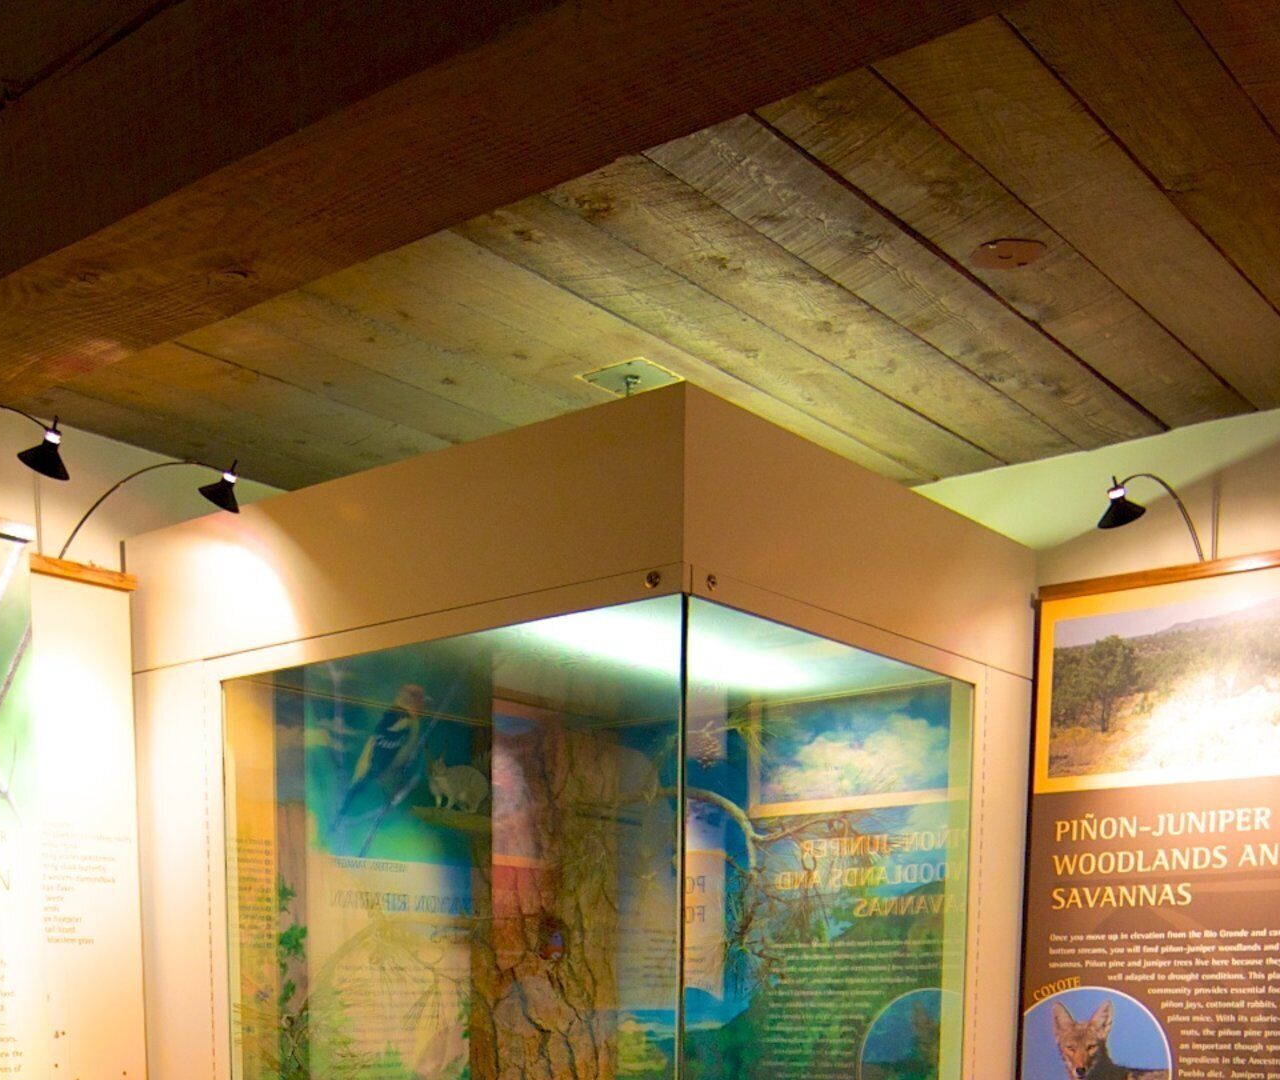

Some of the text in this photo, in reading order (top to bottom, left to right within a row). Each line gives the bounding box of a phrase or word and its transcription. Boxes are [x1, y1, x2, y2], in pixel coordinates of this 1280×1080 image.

[1055, 807, 1271, 842] PIÑON-JUNIPER
[1053, 846, 1228, 876] WOODLANDS
[1051, 882, 1192, 910] SAVANNAS
[1033, 976, 1080, 1001] COYOTE
